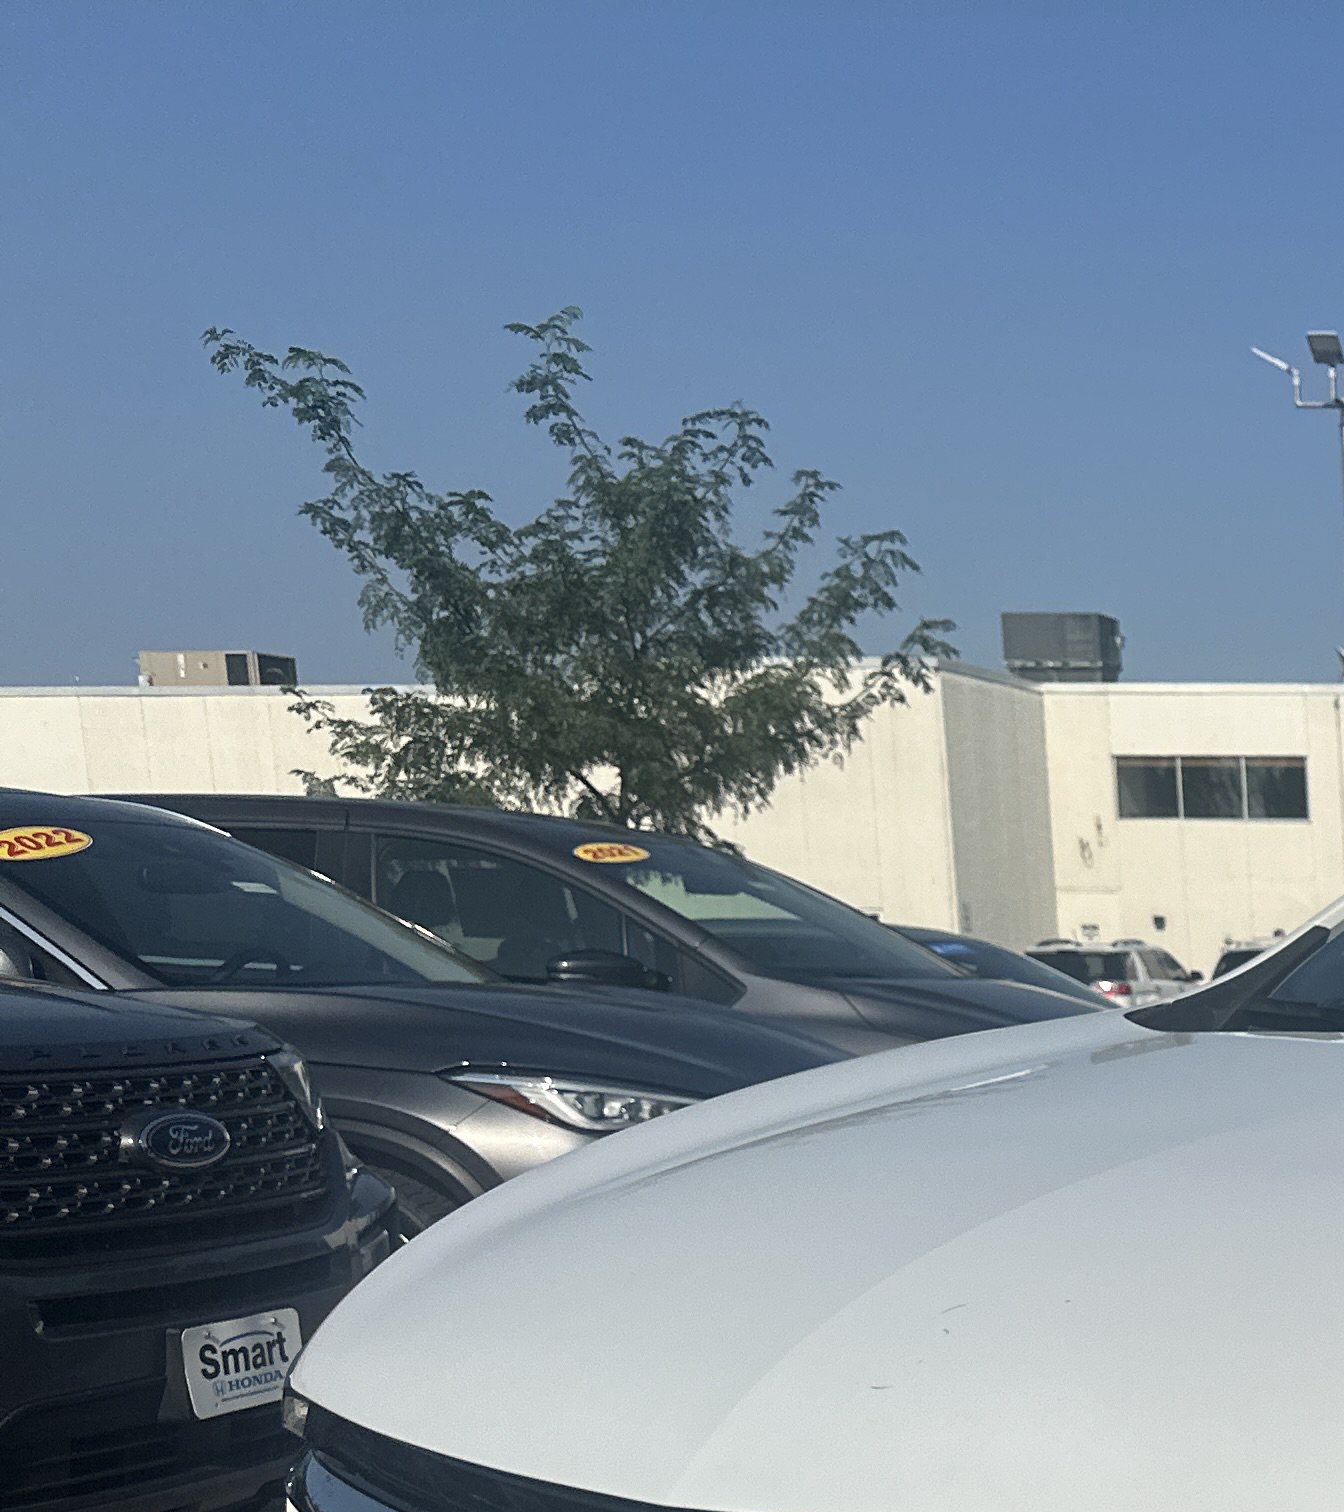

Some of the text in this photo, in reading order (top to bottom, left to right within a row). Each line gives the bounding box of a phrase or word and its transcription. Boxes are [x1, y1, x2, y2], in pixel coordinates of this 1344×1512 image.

[0, 829, 84, 858] 2022
[168, 1124, 215, 1155] Ford
[198, 1331, 289, 1380] Smart
[227, 1369, 284, 1392] HONDA
